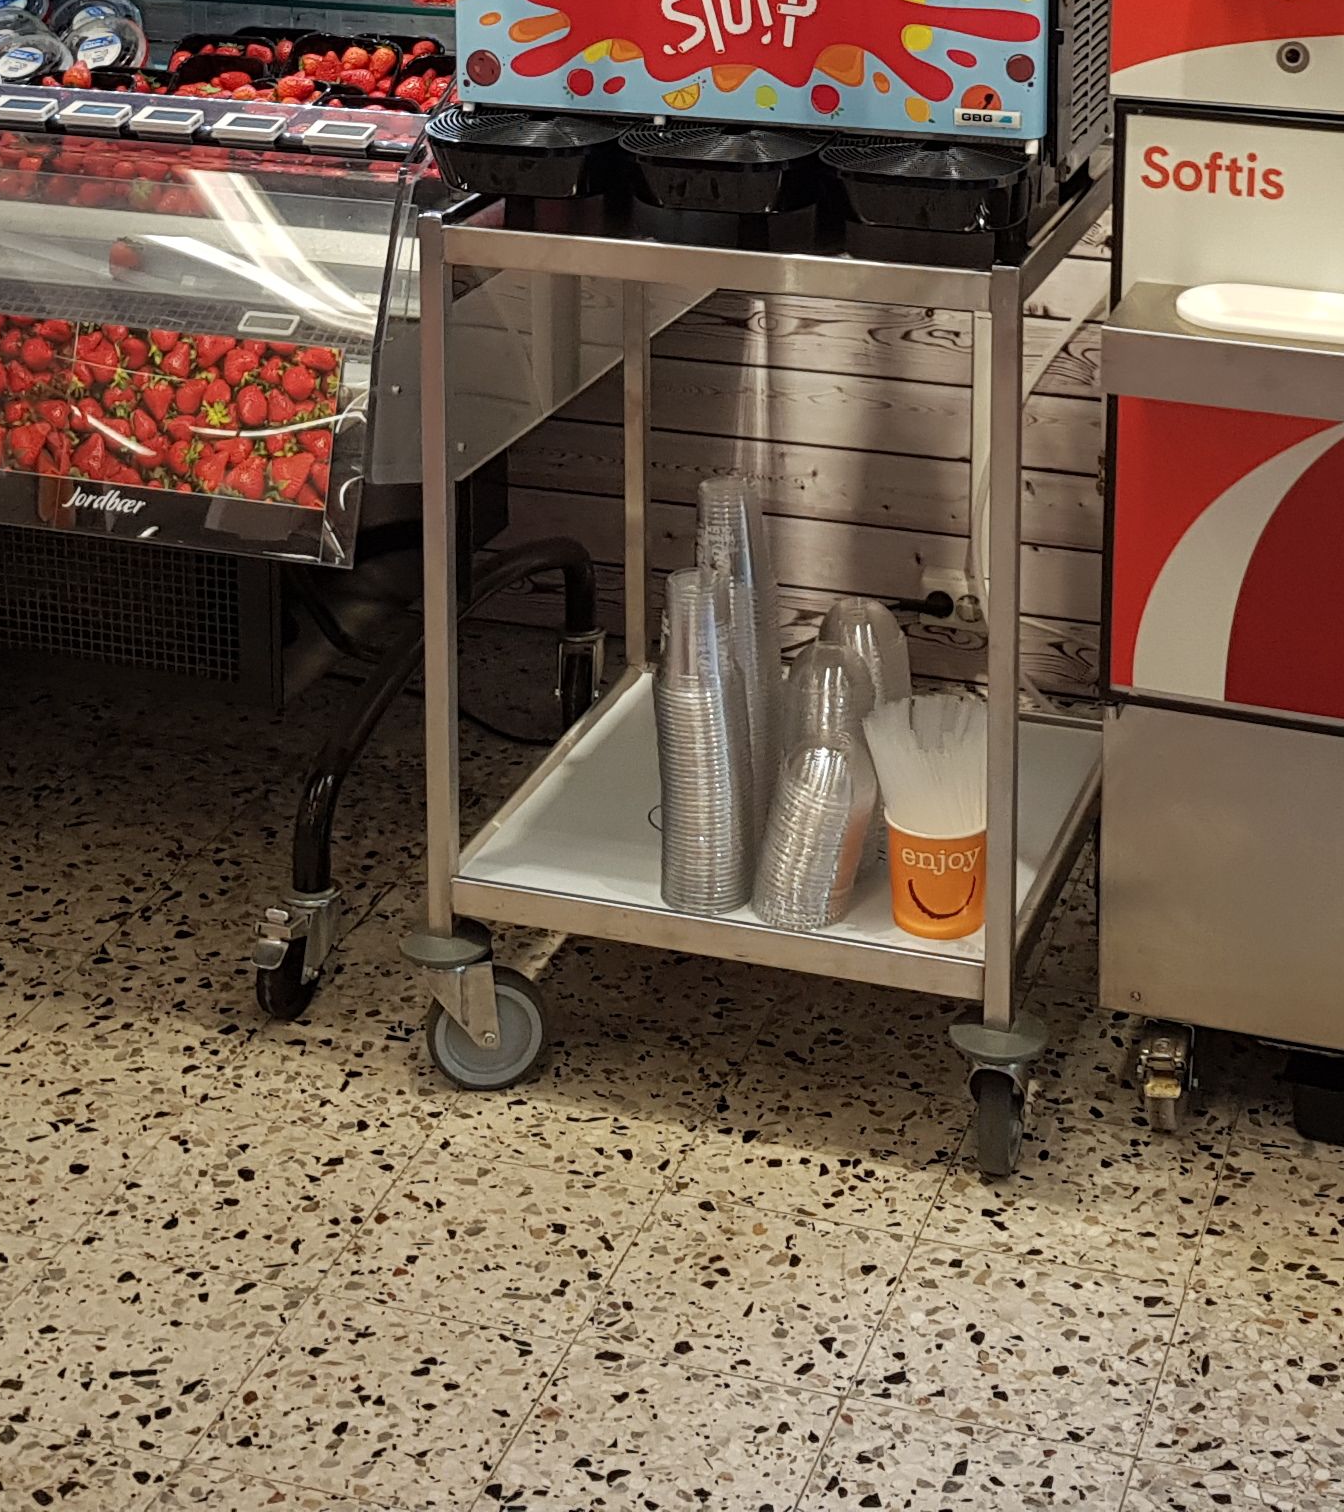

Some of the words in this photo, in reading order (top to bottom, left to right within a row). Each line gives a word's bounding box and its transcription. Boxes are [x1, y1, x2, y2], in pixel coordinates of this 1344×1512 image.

[1141, 145, 1285, 200] Softis
[63, 486, 145, 516] Jordbær
[902, 847, 981, 875] enjoy
